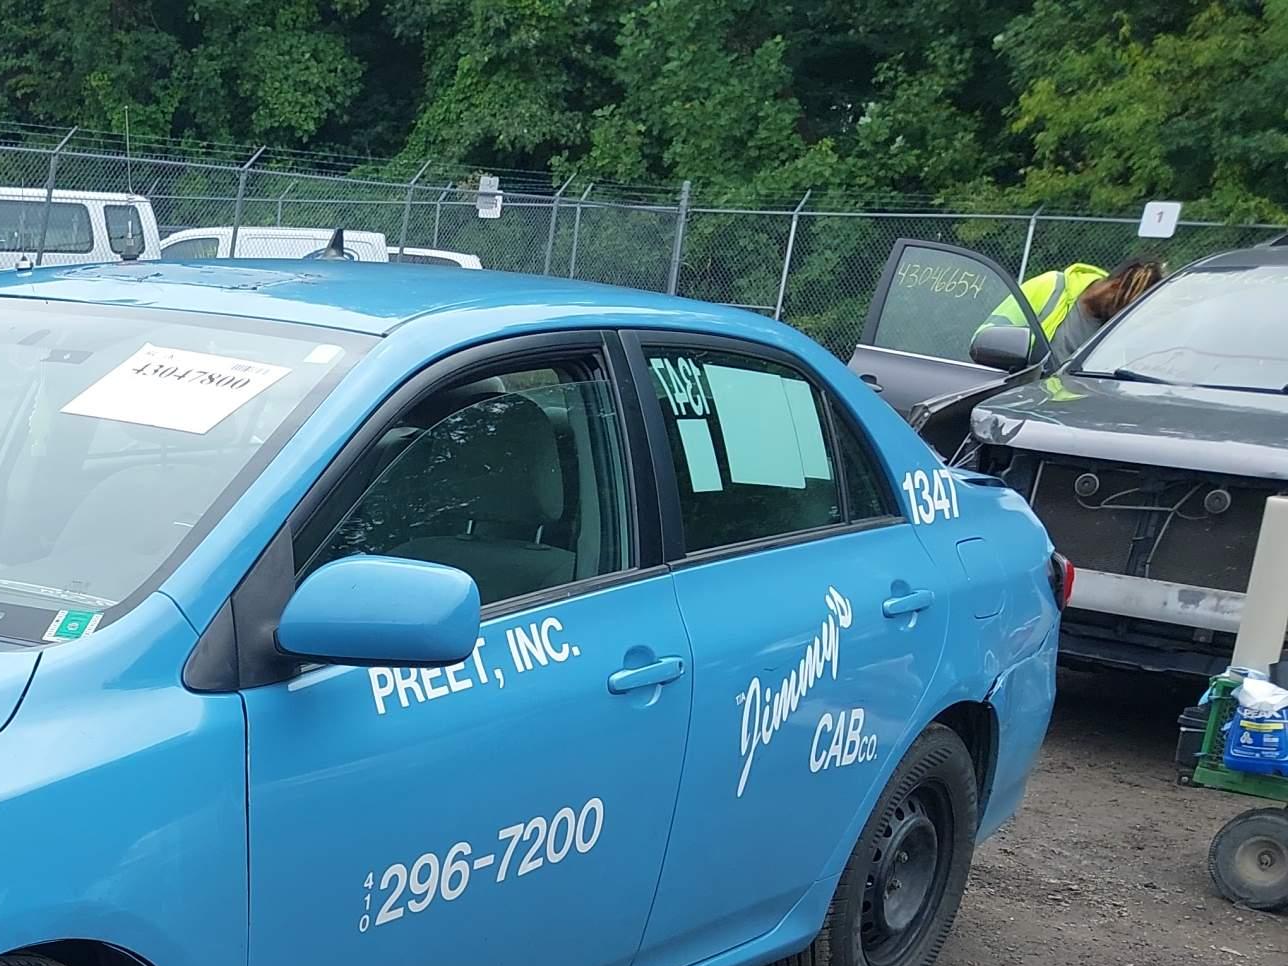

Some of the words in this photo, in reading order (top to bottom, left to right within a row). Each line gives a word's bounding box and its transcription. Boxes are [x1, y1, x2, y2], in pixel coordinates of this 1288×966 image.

[1156, 210, 1165, 224] 1
[897, 262, 987, 299] 43046654
[132, 362, 252, 391] 43047800
[902, 469, 961, 525] 1347
[368, 637, 504, 714] PREET,
[504, 616, 582, 673] INC.
[737, 586, 854, 797] Jimmy's
[808, 708, 866, 774] CAB
[375, 797, 604, 926] 296-7200
